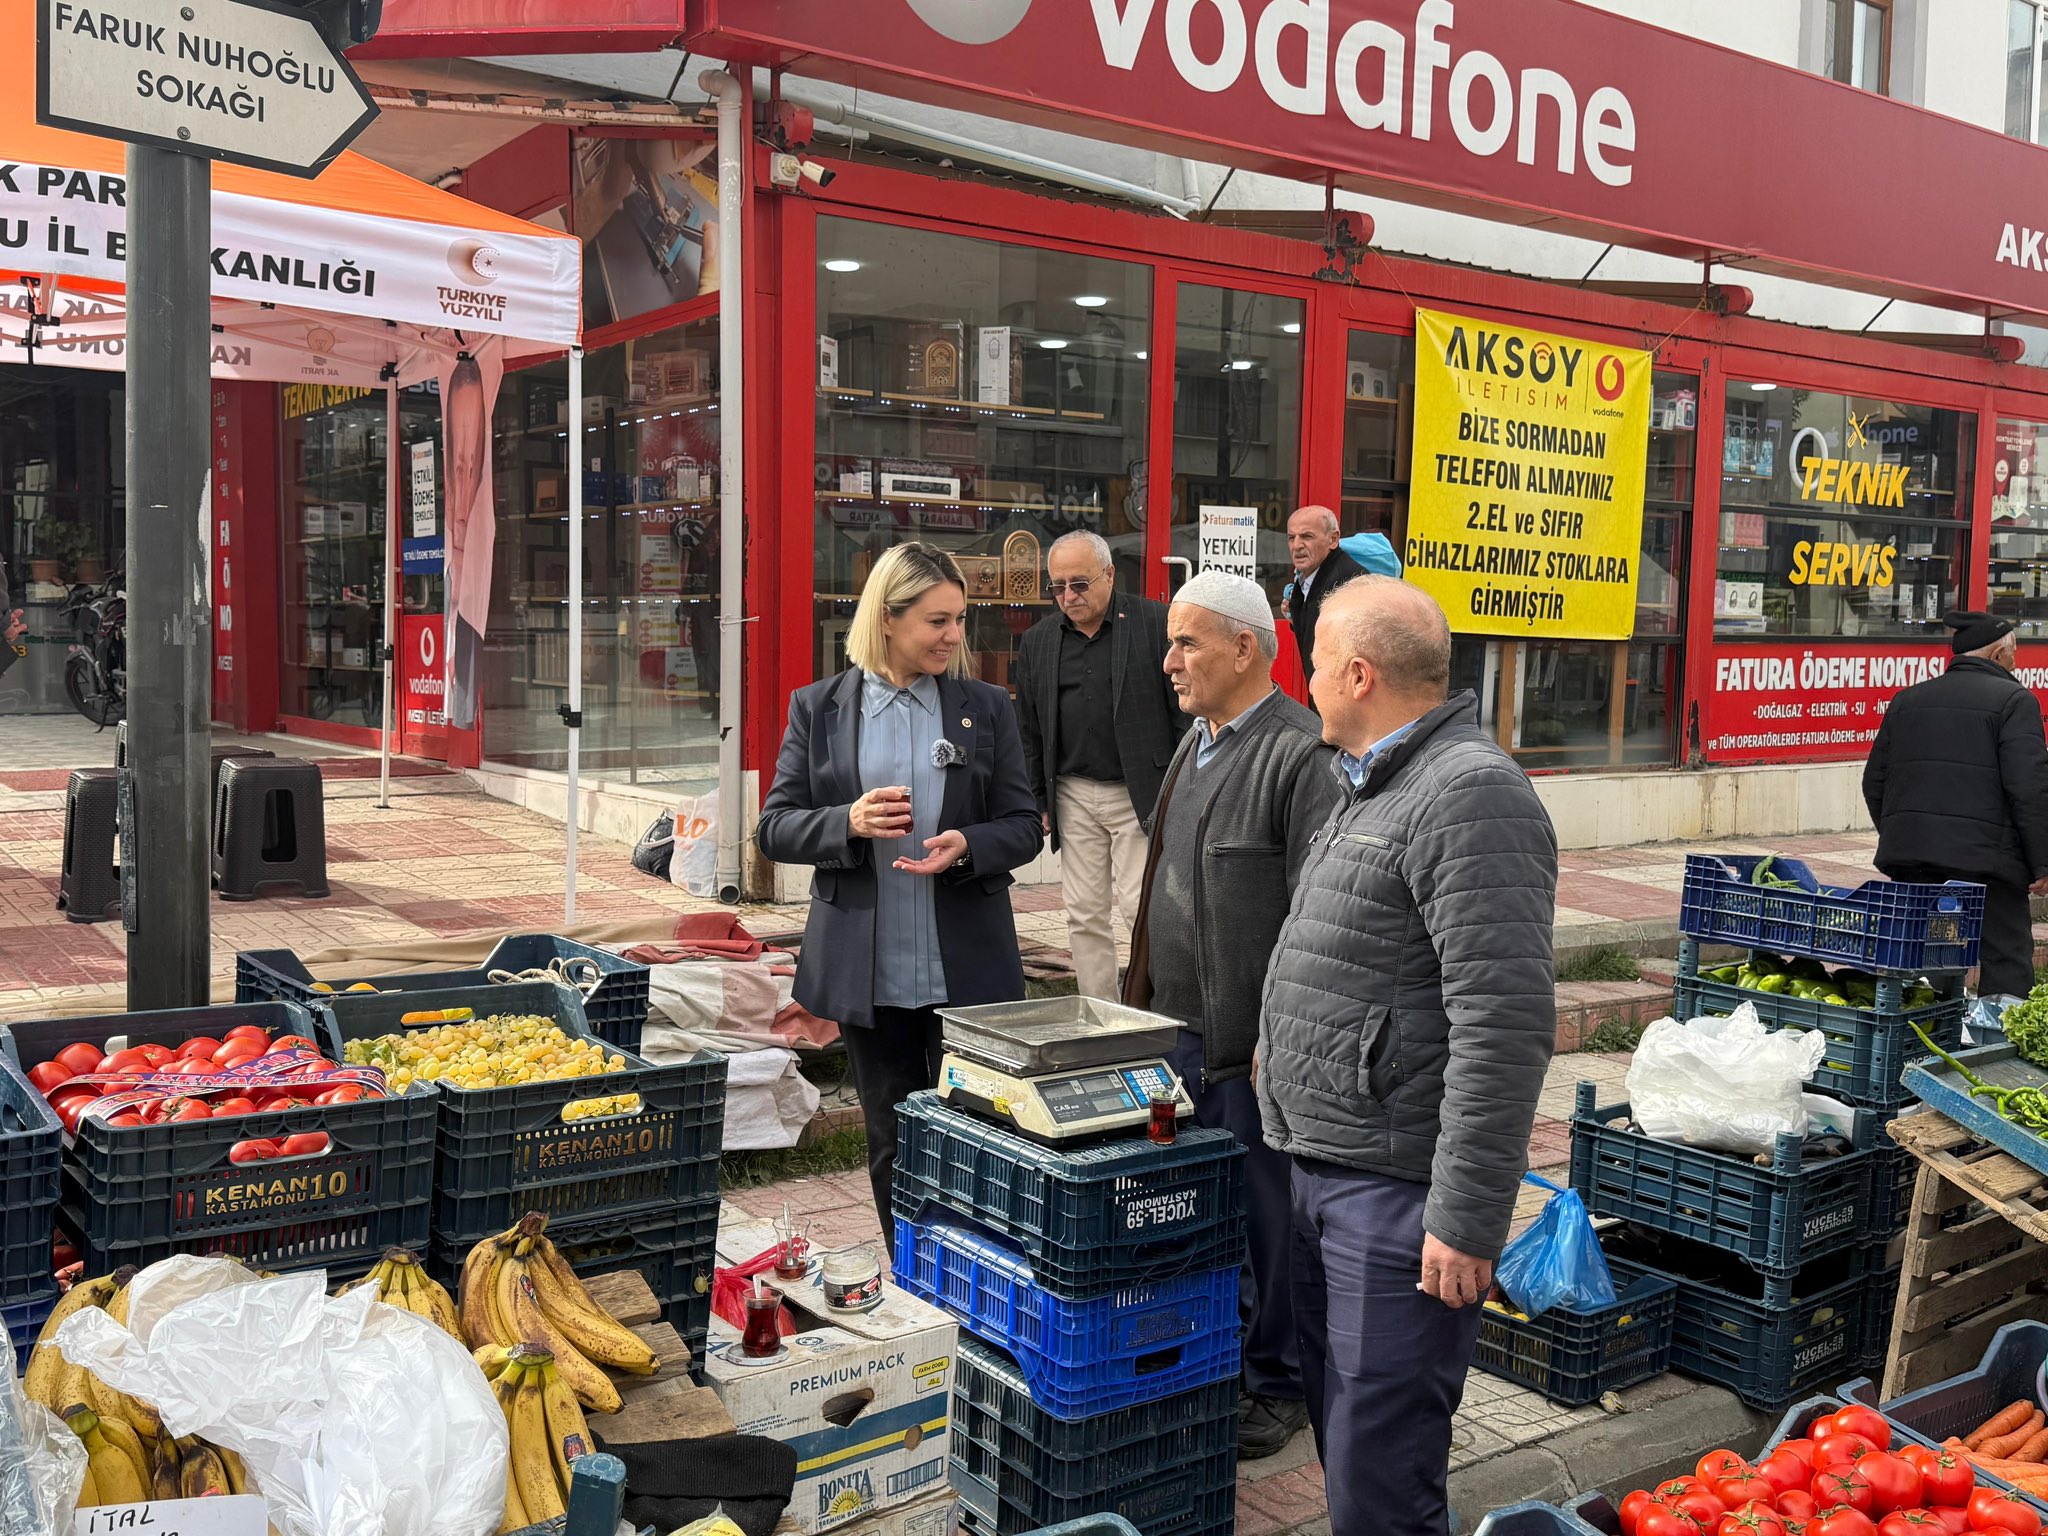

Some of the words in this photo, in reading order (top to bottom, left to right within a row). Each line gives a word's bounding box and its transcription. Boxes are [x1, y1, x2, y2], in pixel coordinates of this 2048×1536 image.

[55, 2, 166, 55] FARUK
[178, 31, 335, 94] NUHOĞLU
[136, 69, 265, 122] SOKAĞI
[1089, 0, 1637, 187] vodafone
[37, 167, 126, 207] PAR
[0, 217, 28, 248] U
[48, 215, 89, 256] İL
[1995, 222, 2048, 273] AK
[1444, 326, 1583, 387] AKSOY
[1592, 407, 1625, 419] vodafone
[1458, 407, 1500, 446] BİZE
[1505, 419, 1607, 460] SORMADAN
[1435, 453, 1521, 491] TELEFON
[1526, 465, 1615, 502] ALMAYINIZ
[1210, 514, 1255, 527] Faturamatik
[1466, 501, 1508, 532] 2.EL
[1515, 511, 1535, 535] ve
[1540, 508, 1584, 540] SIFIR
[1202, 536, 1254, 556] YETKİLİ
[1405, 533, 1541, 578] CİHAZLARIMIZ
[1545, 550, 1629, 584] STOKLARA
[1470, 582, 1565, 626] GİRMİŞTİR
[409, 673, 445, 695] vodafon
[1715, 657, 1796, 692] FATURA
[1799, 651, 1865, 690] ÖDEME
[1868, 656, 1946, 688] NOKTASI
[1757, 702, 1803, 719] DOĞALGAZ
[1810, 700, 1848, 717] ELEKTRİK
[1854, 701, 1866, 715] SU
[1876, 698, 1891, 715] İNT
[1707, 738, 1717, 751] ve
[1719, 735, 1736, 750] TÜM
[1736, 732, 1801, 749] OPERATÖRLERDE
[1801, 732, 1830, 746] FATURA
[1830, 728, 1856, 744] ÖDEME
[1856, 731, 1865, 742] ve
[538, 1147, 621, 1169] KASTAMONU
[206, 1192, 307, 1216] KASTAMONU
[1126, 1199, 1196, 1230] YÜCEL-59
[1127, 1188, 1197, 1212] KASTAMONU
[789, 1364, 862, 1397] PREMIUM
[867, 1351, 905, 1376] PACK
[918, 1364, 932, 1374] FARM
[932, 1361, 944, 1371] CODE
[817, 1468, 874, 1515] BONITA
[818, 1512, 849, 1529] PREMIUM
[847, 1503, 875, 1518] BANANAS
